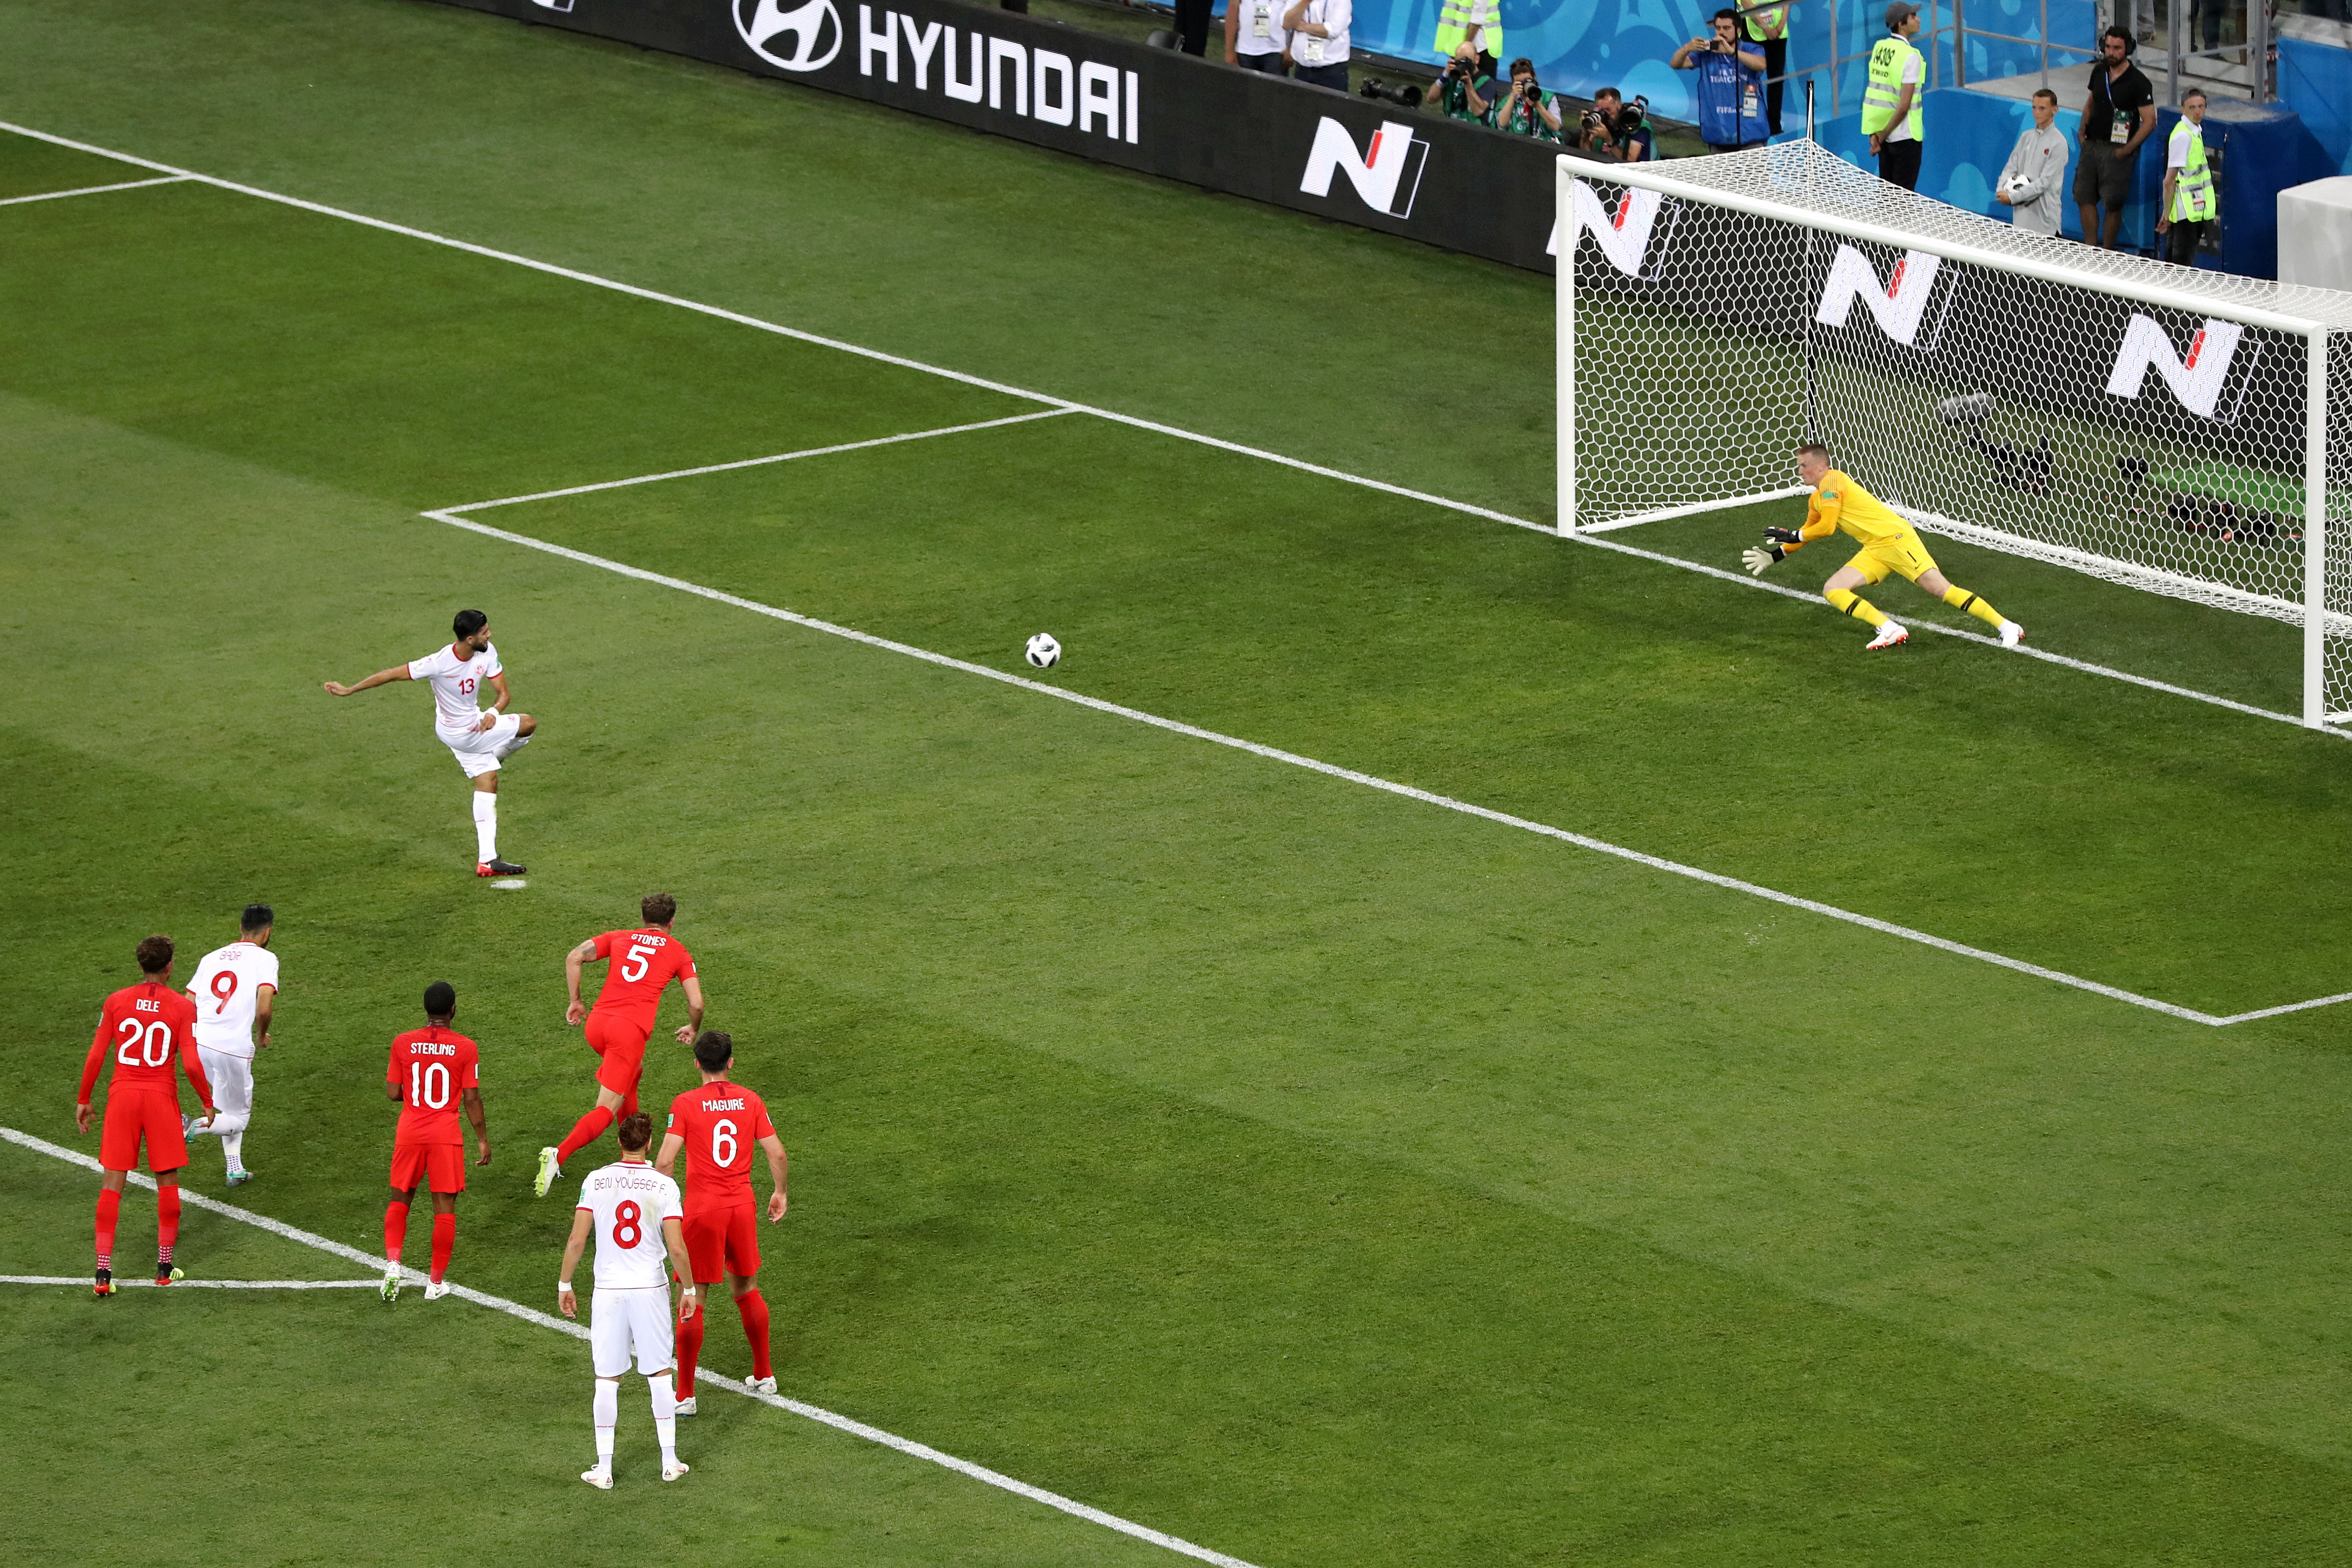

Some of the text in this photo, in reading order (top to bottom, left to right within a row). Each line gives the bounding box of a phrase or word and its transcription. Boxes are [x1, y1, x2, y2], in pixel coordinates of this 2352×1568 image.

[859, 4, 1138, 144] HYUNDAI
[458, 678, 475, 695] 13
[631, 933, 667, 947] STONES
[621, 944, 657, 983] 5
[136, 999, 160, 1012] DELE
[211, 970, 237, 1014] 9
[118, 1017, 172, 1067] 20
[410, 1042, 455, 1056] STERLING
[411, 1061, 450, 1110] 10
[702, 1098, 745, 1112] MAGUIRE
[712, 1119, 738, 1168] 6
[594, 1176, 667, 1196] BEN YOUSSEF F.
[613, 1200, 642, 1250] 8
